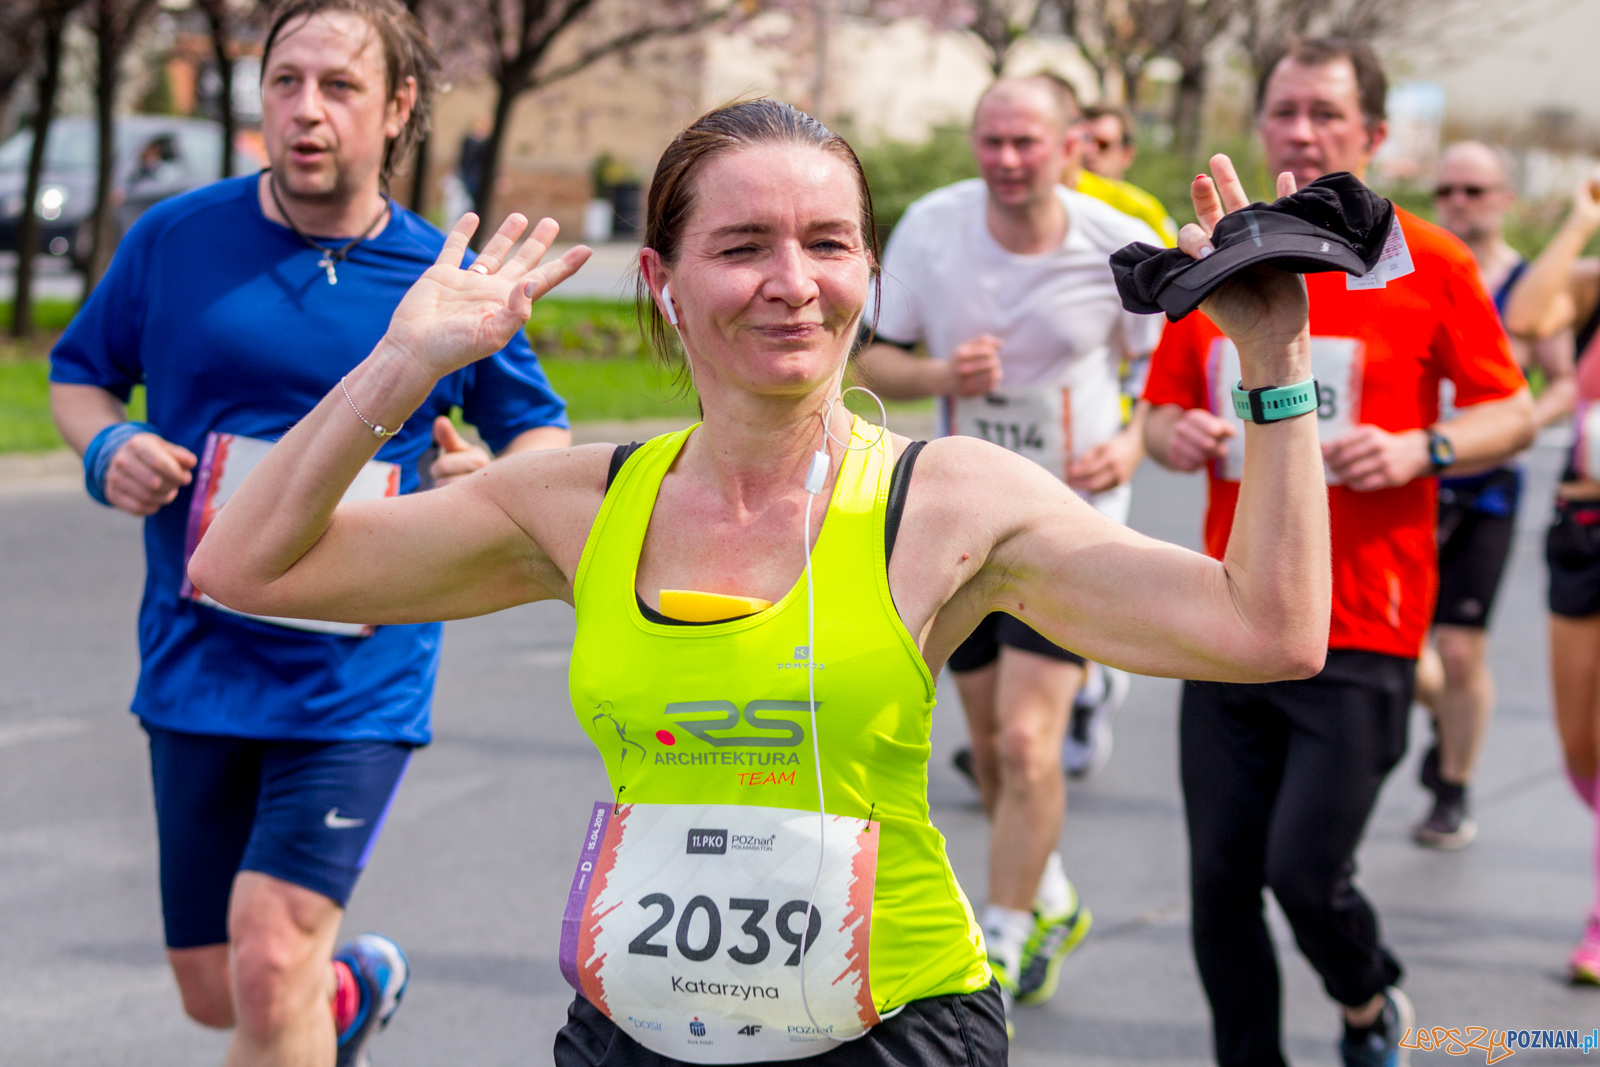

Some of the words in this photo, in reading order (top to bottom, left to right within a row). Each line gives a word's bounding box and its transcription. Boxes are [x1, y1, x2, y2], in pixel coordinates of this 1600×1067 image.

[776, 662, 825, 670] DOMYOS
[664, 700, 823, 748] RS
[654, 752, 800, 766] ARCHITEKTURA
[737, 770, 796, 786] TEAM
[587, 808, 605, 850] 15.04.2018
[580, 861, 592, 872] D
[628, 892, 822, 967] 2039
[671, 976, 779, 1000] Katarzyna
[737, 1025, 763, 1036] 4F
